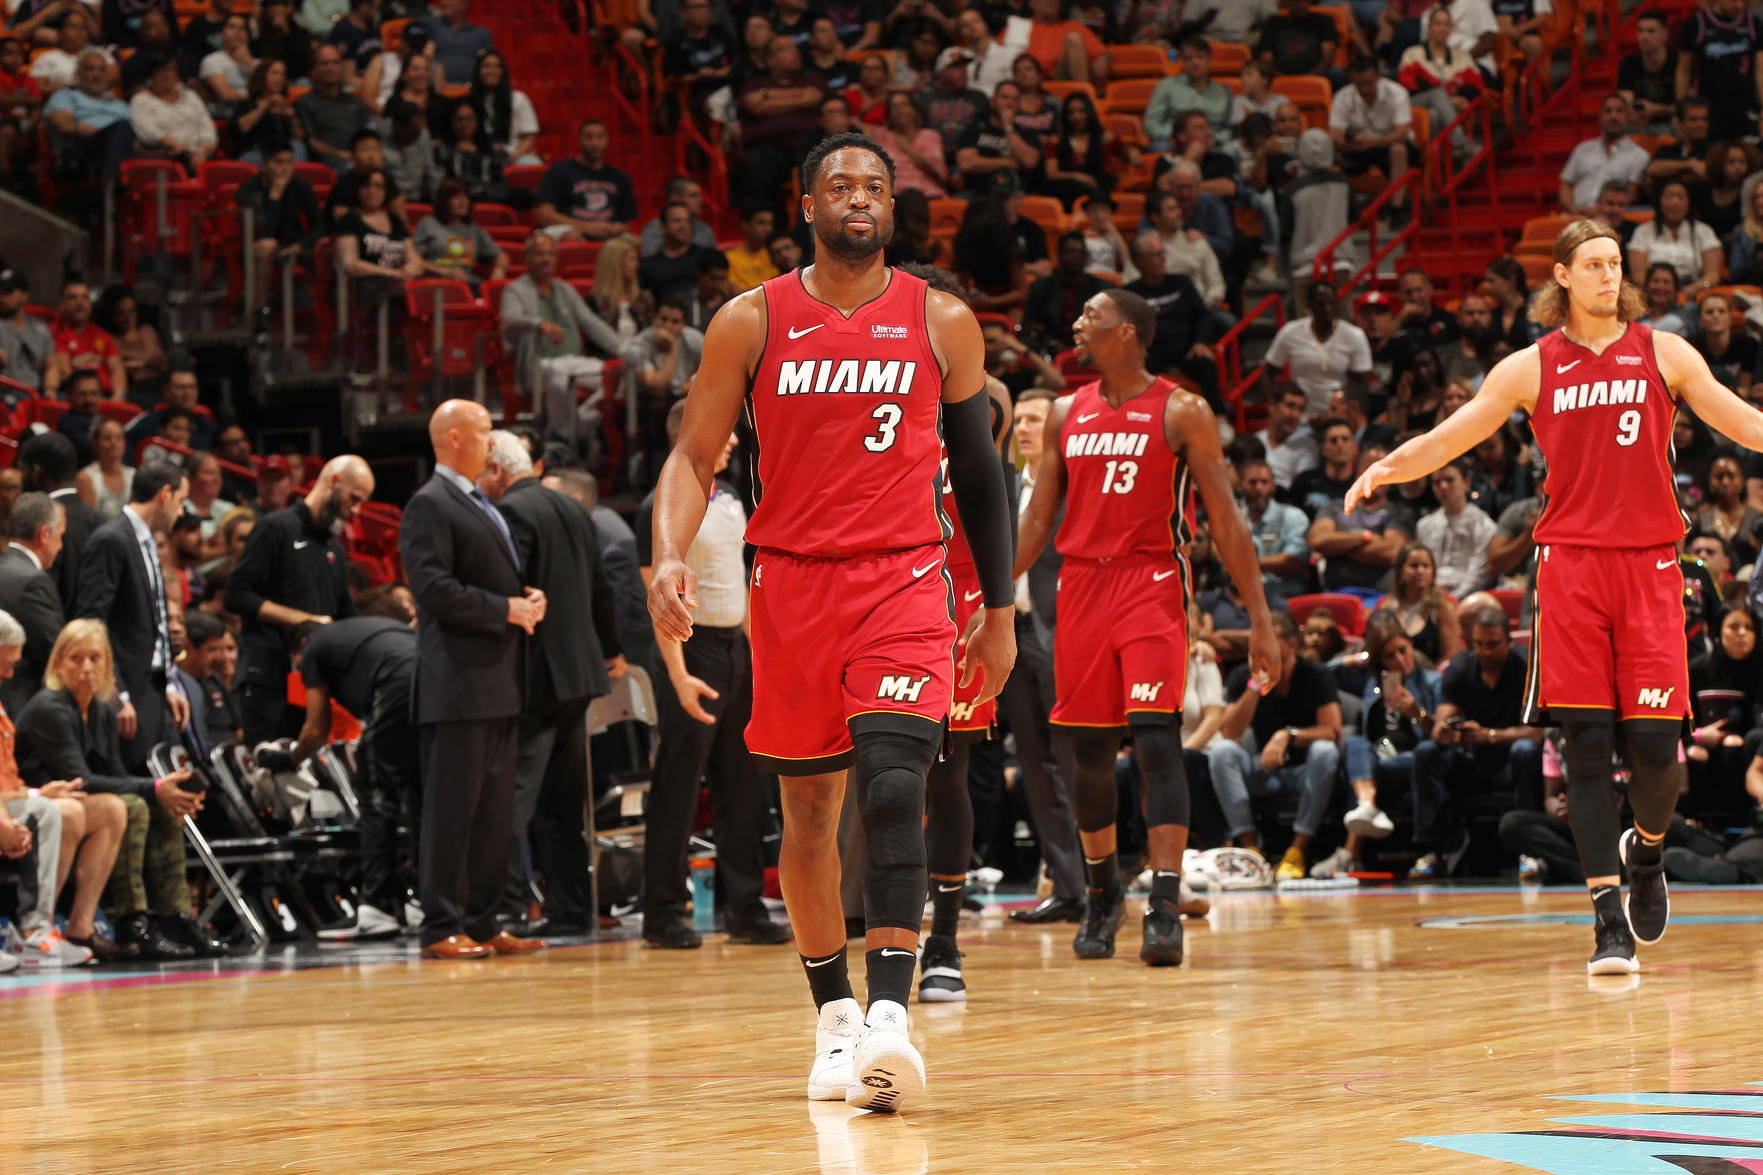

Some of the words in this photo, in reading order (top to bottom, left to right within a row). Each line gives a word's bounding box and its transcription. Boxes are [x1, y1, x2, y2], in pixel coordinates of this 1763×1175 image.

[871, 324, 908, 334] Ultimate
[776, 359, 918, 397] MIAMI
[1553, 378, 1648, 415] MIAMI
[863, 402, 904, 453] 3
[1065, 432, 1150, 459] MIAMI
[1615, 409, 1642, 447] 9
[1101, 460, 1139, 495] 13
